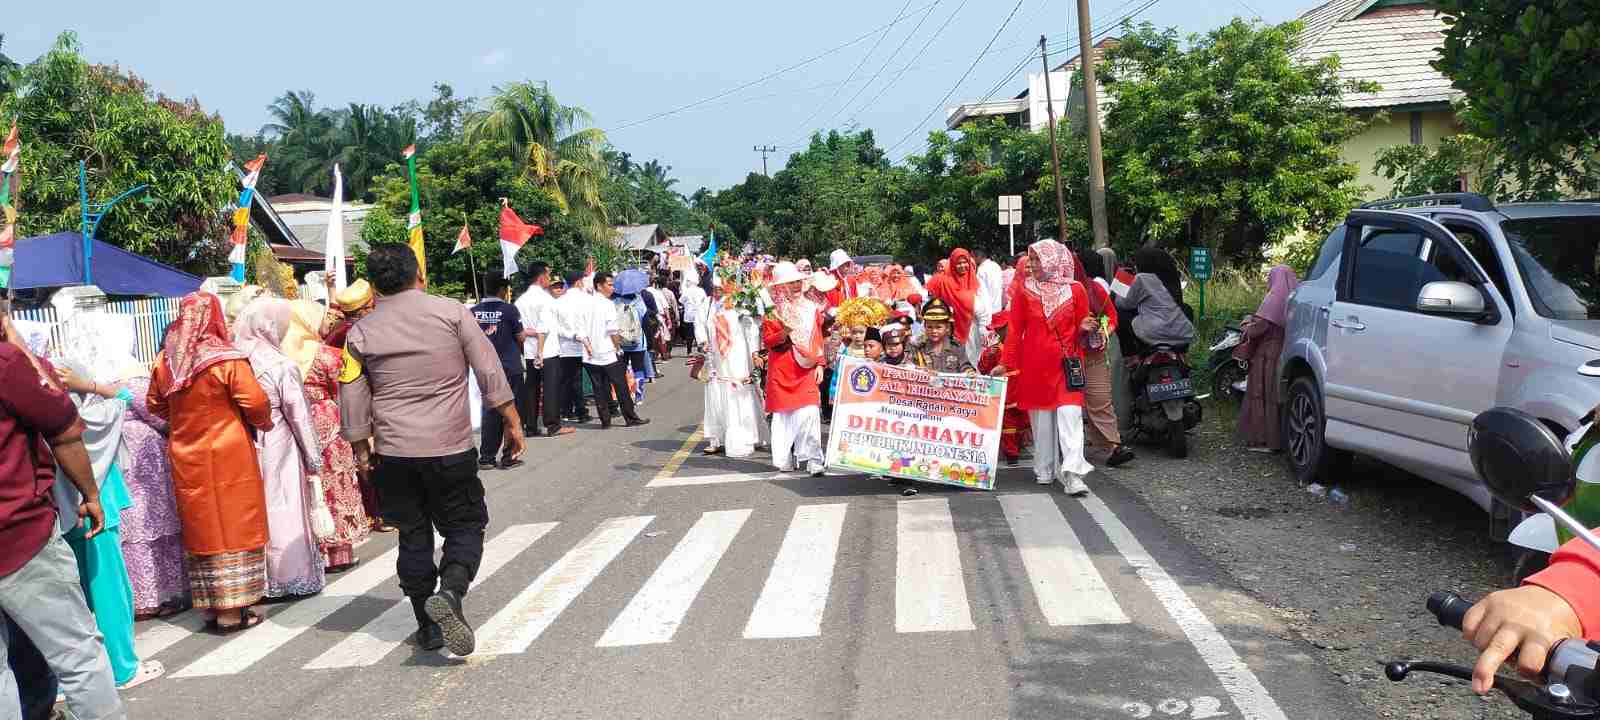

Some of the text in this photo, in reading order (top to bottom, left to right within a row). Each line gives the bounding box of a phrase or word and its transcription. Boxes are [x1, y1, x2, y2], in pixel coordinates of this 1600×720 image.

[889, 395, 912, 407] Desa
[915, 399, 946, 413] Ranah
[847, 414, 985, 448] DIRGAHAYU
